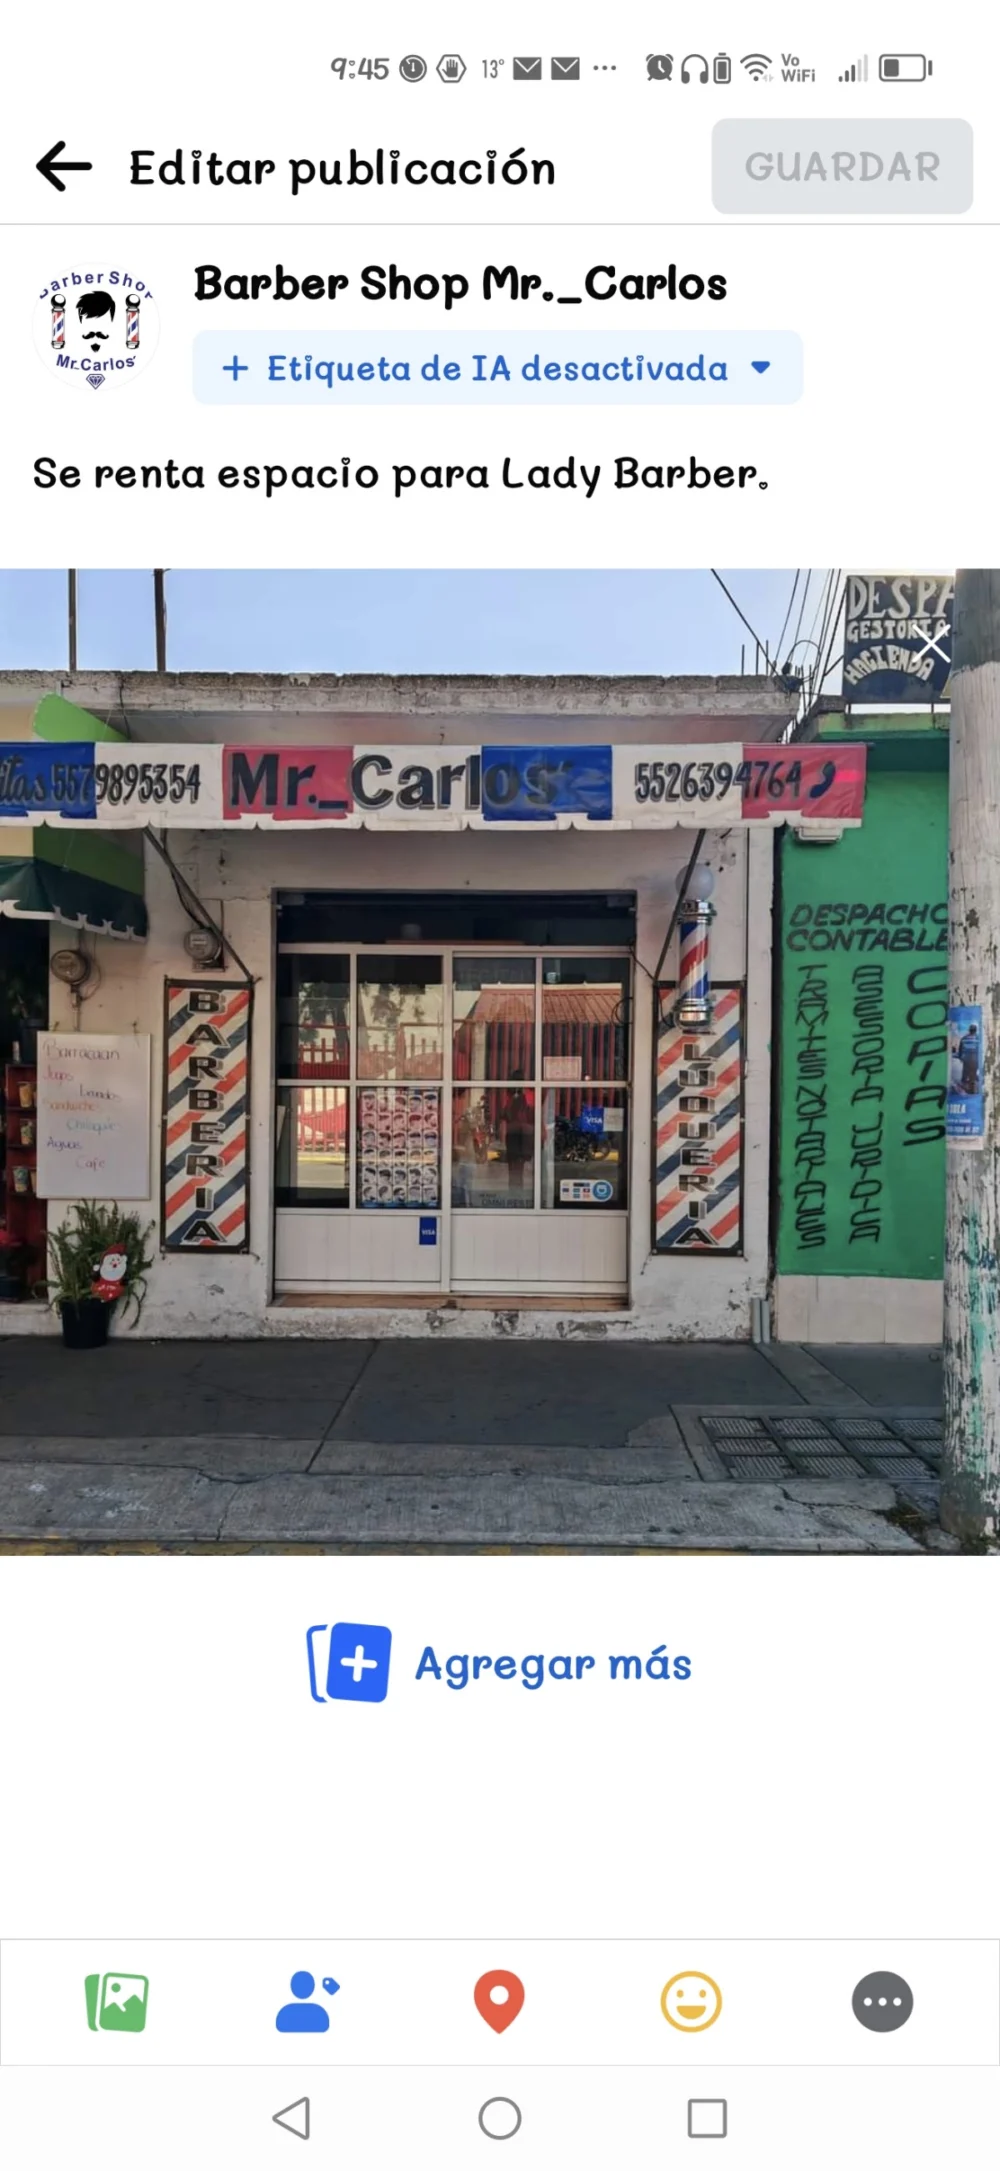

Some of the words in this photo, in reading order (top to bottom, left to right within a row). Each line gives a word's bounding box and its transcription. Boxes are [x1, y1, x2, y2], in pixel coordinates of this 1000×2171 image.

[331, 57, 390, 80] 9:45
[482, 59, 504, 79] 13°
[781, 53, 800, 66] Vo
[781, 68, 816, 83] WiFi
[130, 148, 275, 186] Editar
[288, 147, 555, 196] publicación
[746, 151, 939, 181] GUARDAR
[194, 264, 349, 301] Barber
[361, 263, 469, 310] Shop
[483, 263, 727, 304] Mr._Carlos
[268, 355, 411, 389] Etiqueta
[421, 354, 461, 381] de
[472, 355, 511, 381] IA
[521, 354, 728, 381] desactivada
[34, 457, 81, 489] Se
[95, 459, 205, 489] renta
[218, 457, 379, 498] espacio
[392, 465, 489, 498] para
[502, 456, 601, 499] Lady
[614, 456, 768, 490] Barber.
[52, 762, 201, 806] 5579895354
[634, 761, 802, 803] 5526394764
[902, 966, 948, 1147] COPIAS
[183, 990, 228, 1245] BARBERIA
[584, 1116, 602, 1124] VISA
[421, 1228, 436, 1236] VISA
[415, 1646, 595, 1690] Agregar
[608, 1644, 691, 1680] más
